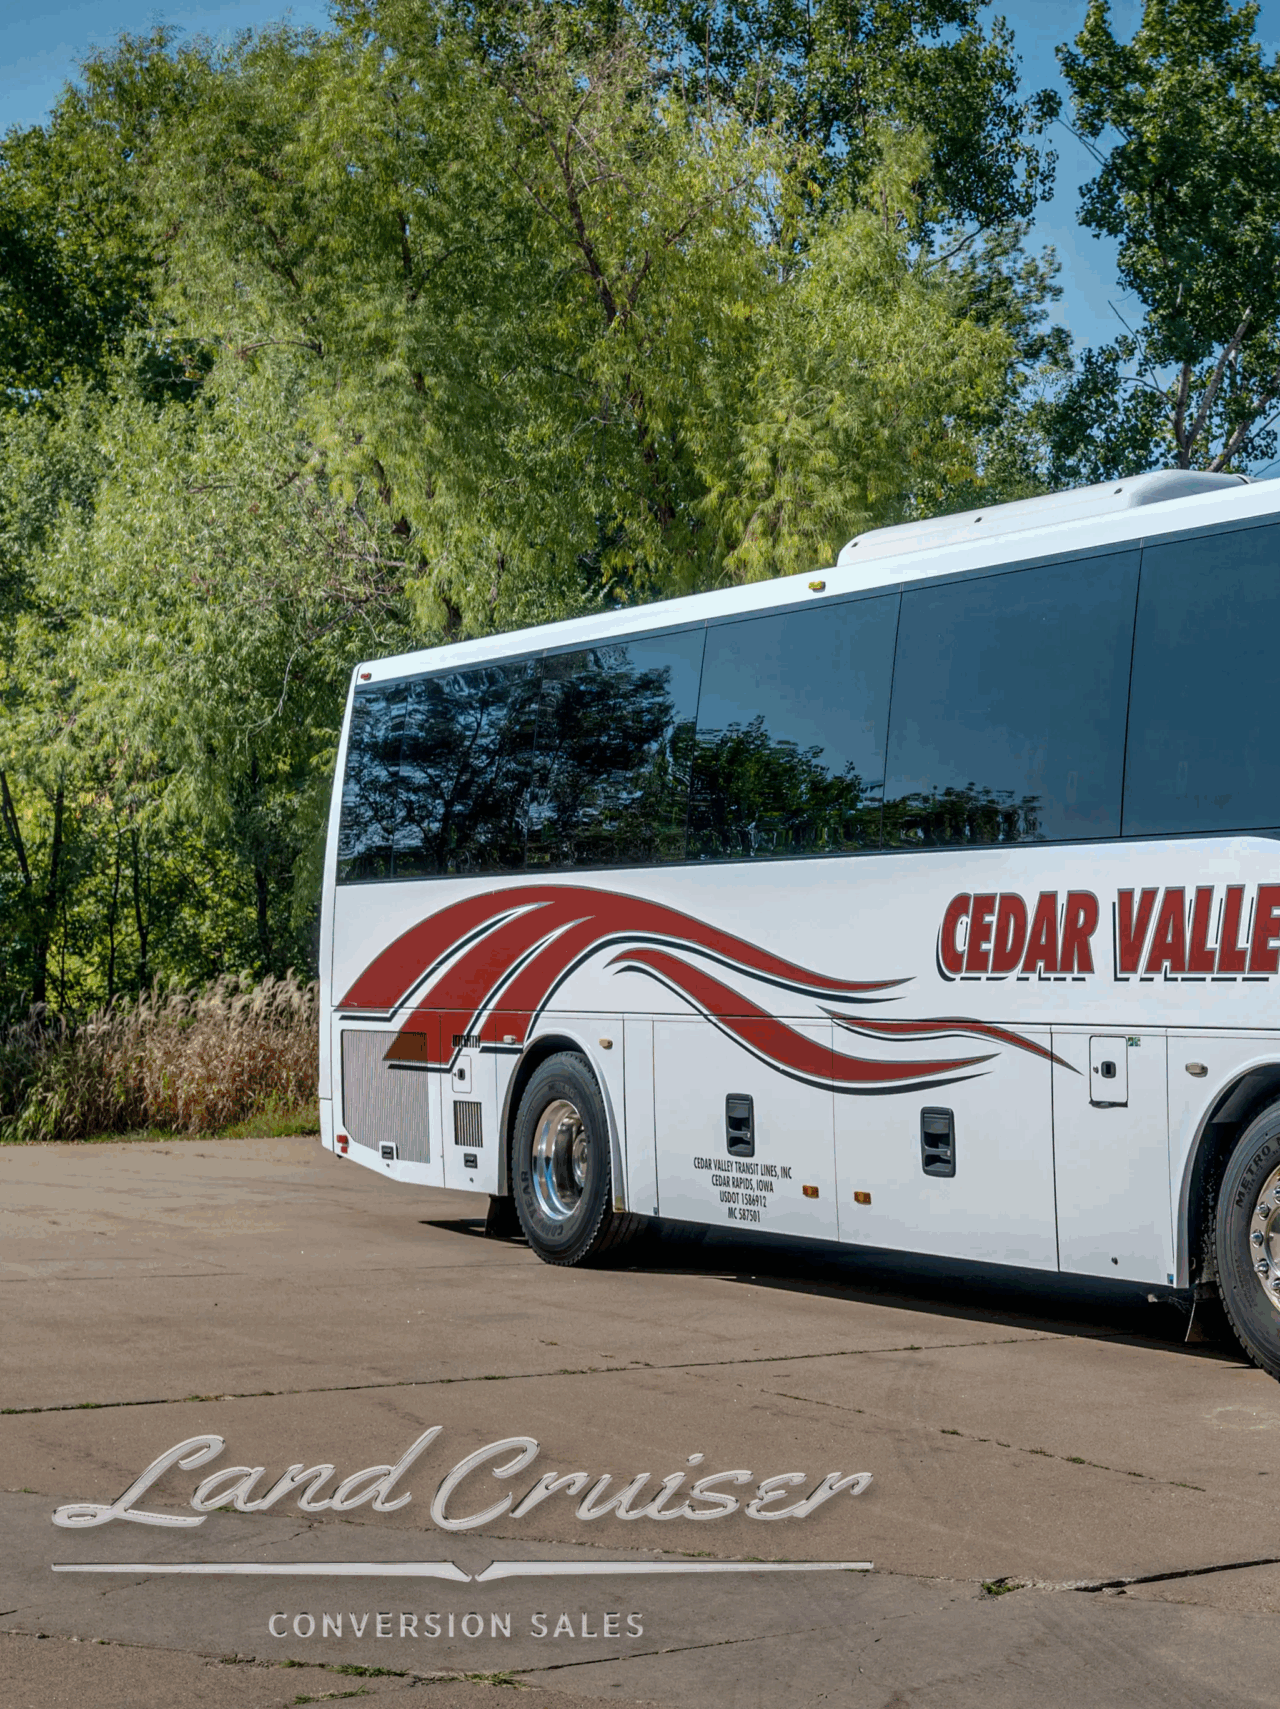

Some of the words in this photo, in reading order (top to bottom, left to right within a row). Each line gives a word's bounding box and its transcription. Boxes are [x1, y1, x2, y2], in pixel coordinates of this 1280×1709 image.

[937, 891, 1100, 982] CEDAR
[693, 1157, 712, 1170] CEDAR
[713, 1159, 734, 1173] VALLEY
[735, 1161, 759, 1176] TRANSIT
[760, 1164, 779, 1180] LINES,
[780, 1166, 792, 1179] INC
[711, 1174, 731, 1187] CEDAR
[731, 1176, 755, 1192] RAPIDS,
[756, 1179, 774, 1193] IOWA
[719, 1190, 739, 1205] USDOT
[741, 1192, 767, 1208] 1586912
[727, 1207, 737, 1220] MC
[738, 1208, 760, 1222] 587501
